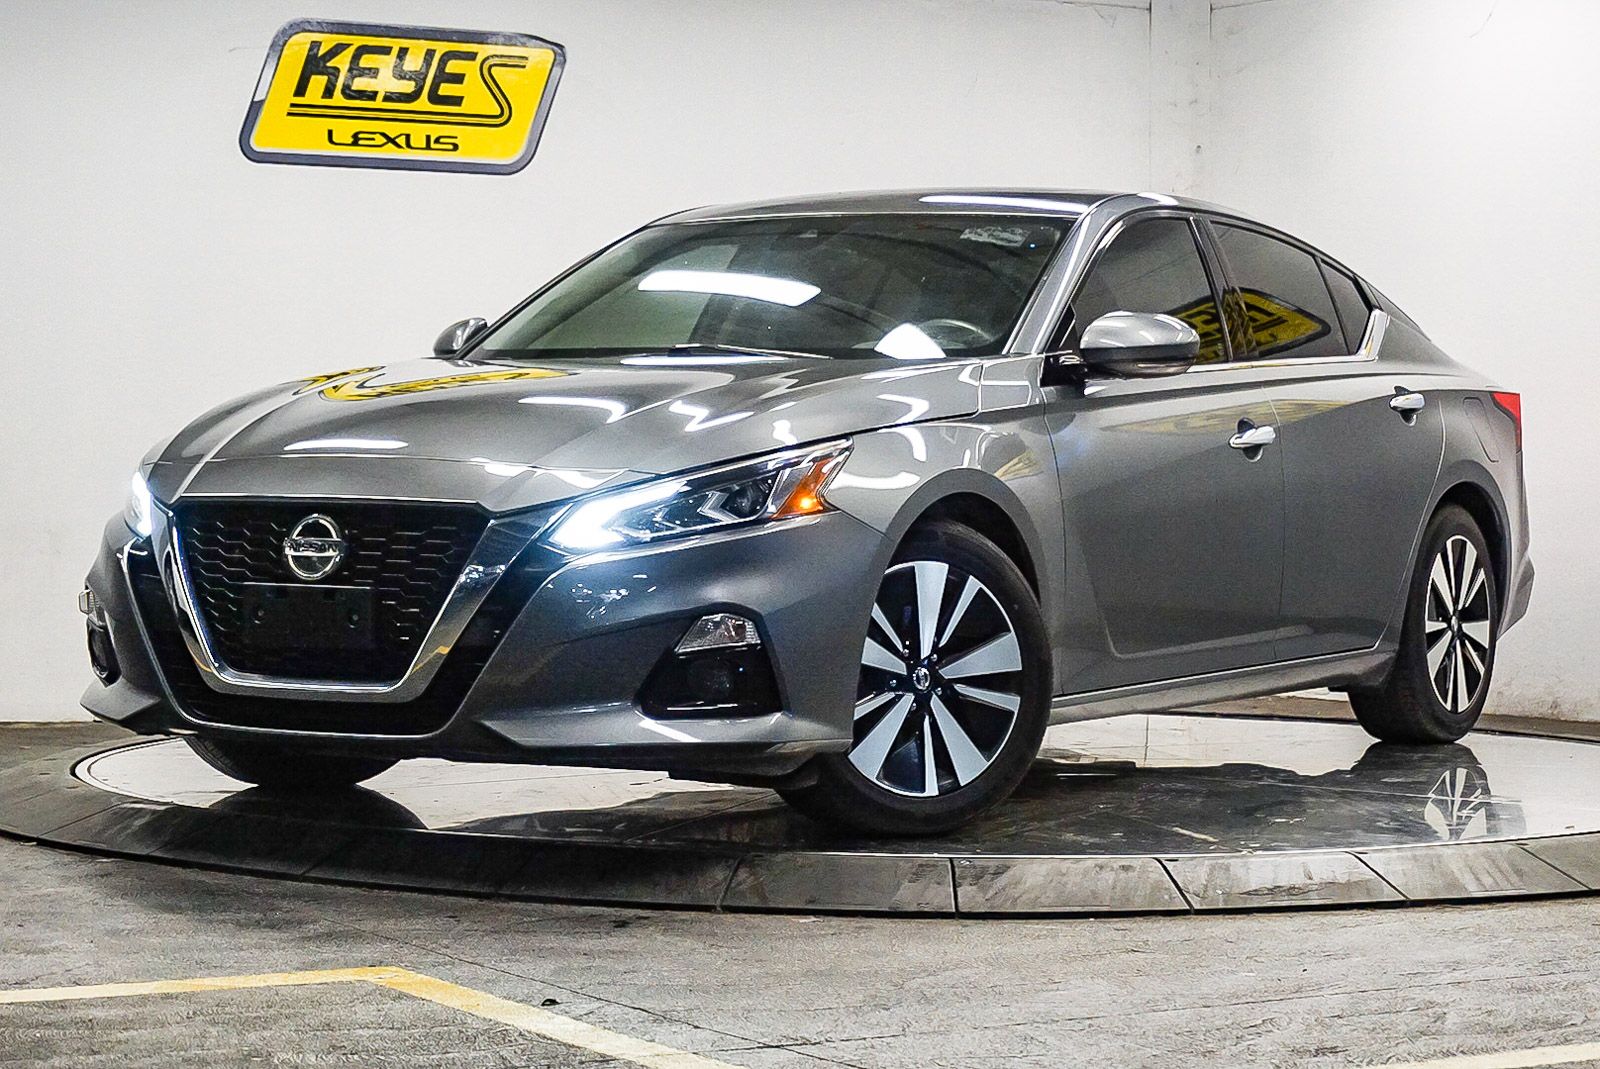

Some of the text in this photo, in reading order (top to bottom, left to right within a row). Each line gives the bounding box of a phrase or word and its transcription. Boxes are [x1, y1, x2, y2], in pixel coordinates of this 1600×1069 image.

[291, 41, 529, 127] KEYES
[326, 129, 460, 152] LEXUS
[285, 539, 340, 553] NISSAN
